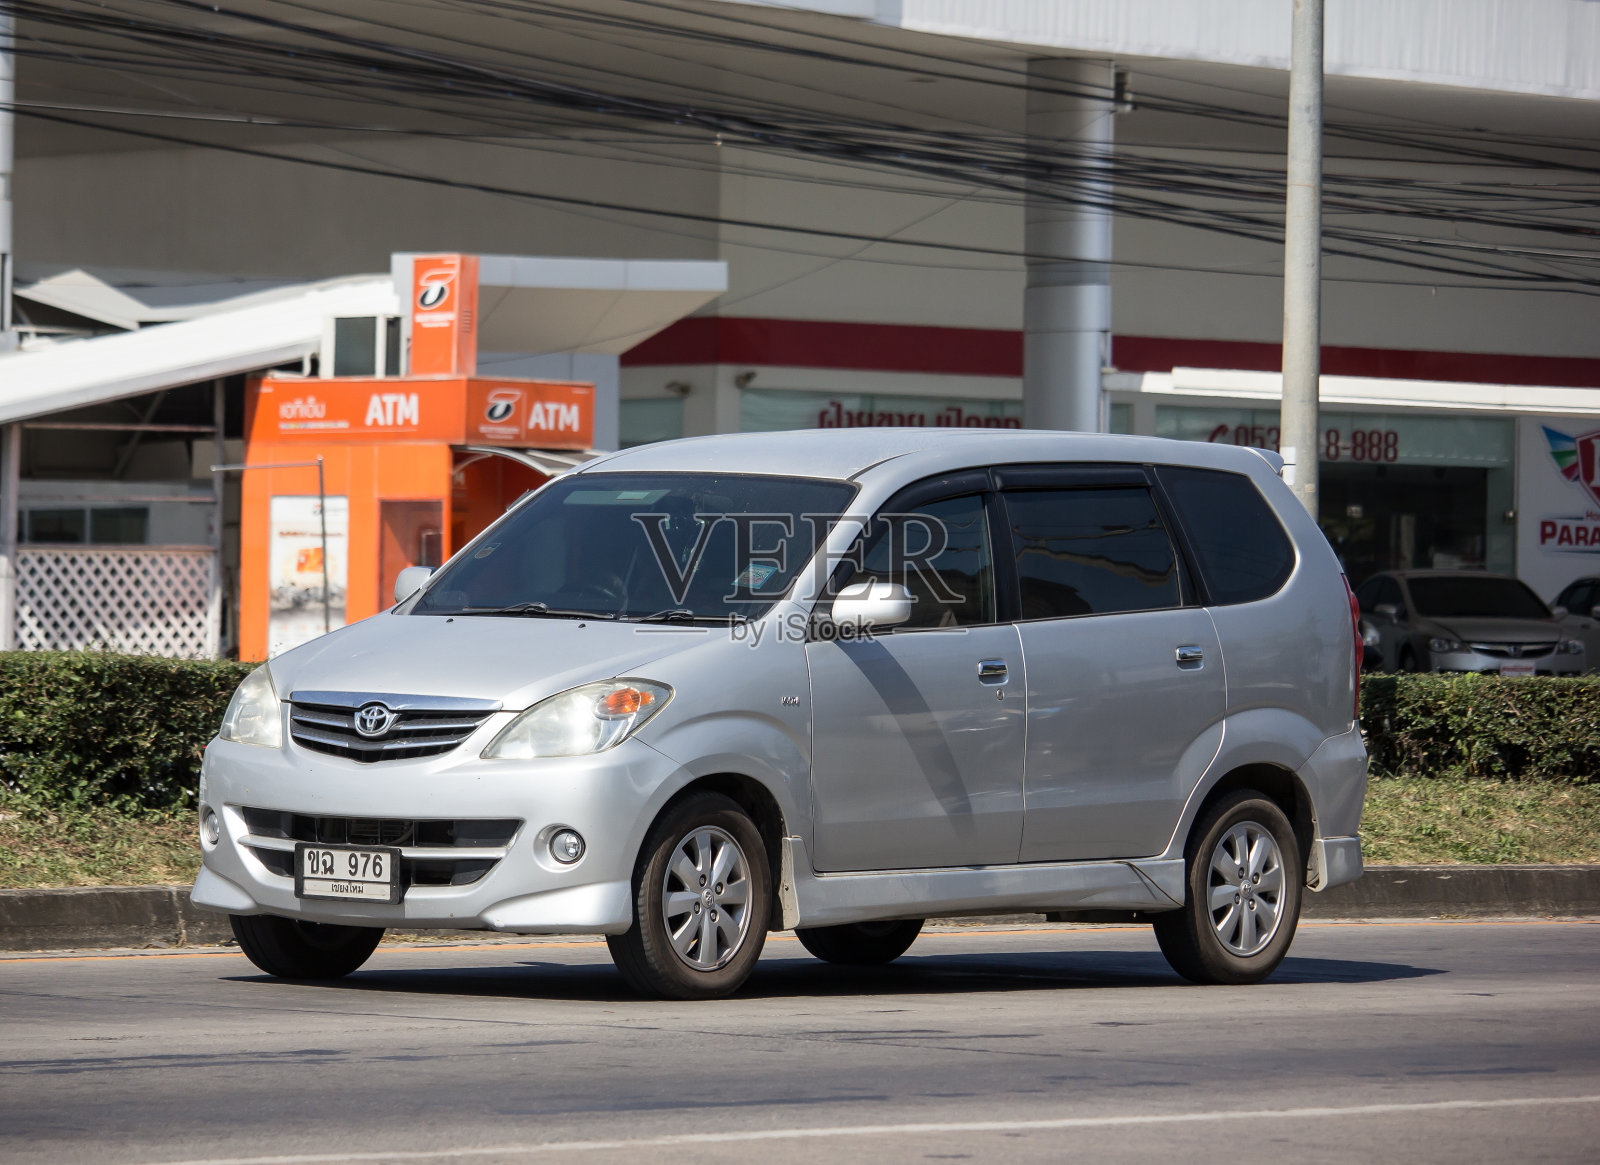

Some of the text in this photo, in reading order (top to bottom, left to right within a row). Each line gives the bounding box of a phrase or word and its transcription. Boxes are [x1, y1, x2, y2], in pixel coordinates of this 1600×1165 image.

[365, 392, 420, 427] ATM
[527, 401, 580, 433] ATM
[348, 853, 383, 878] 976
